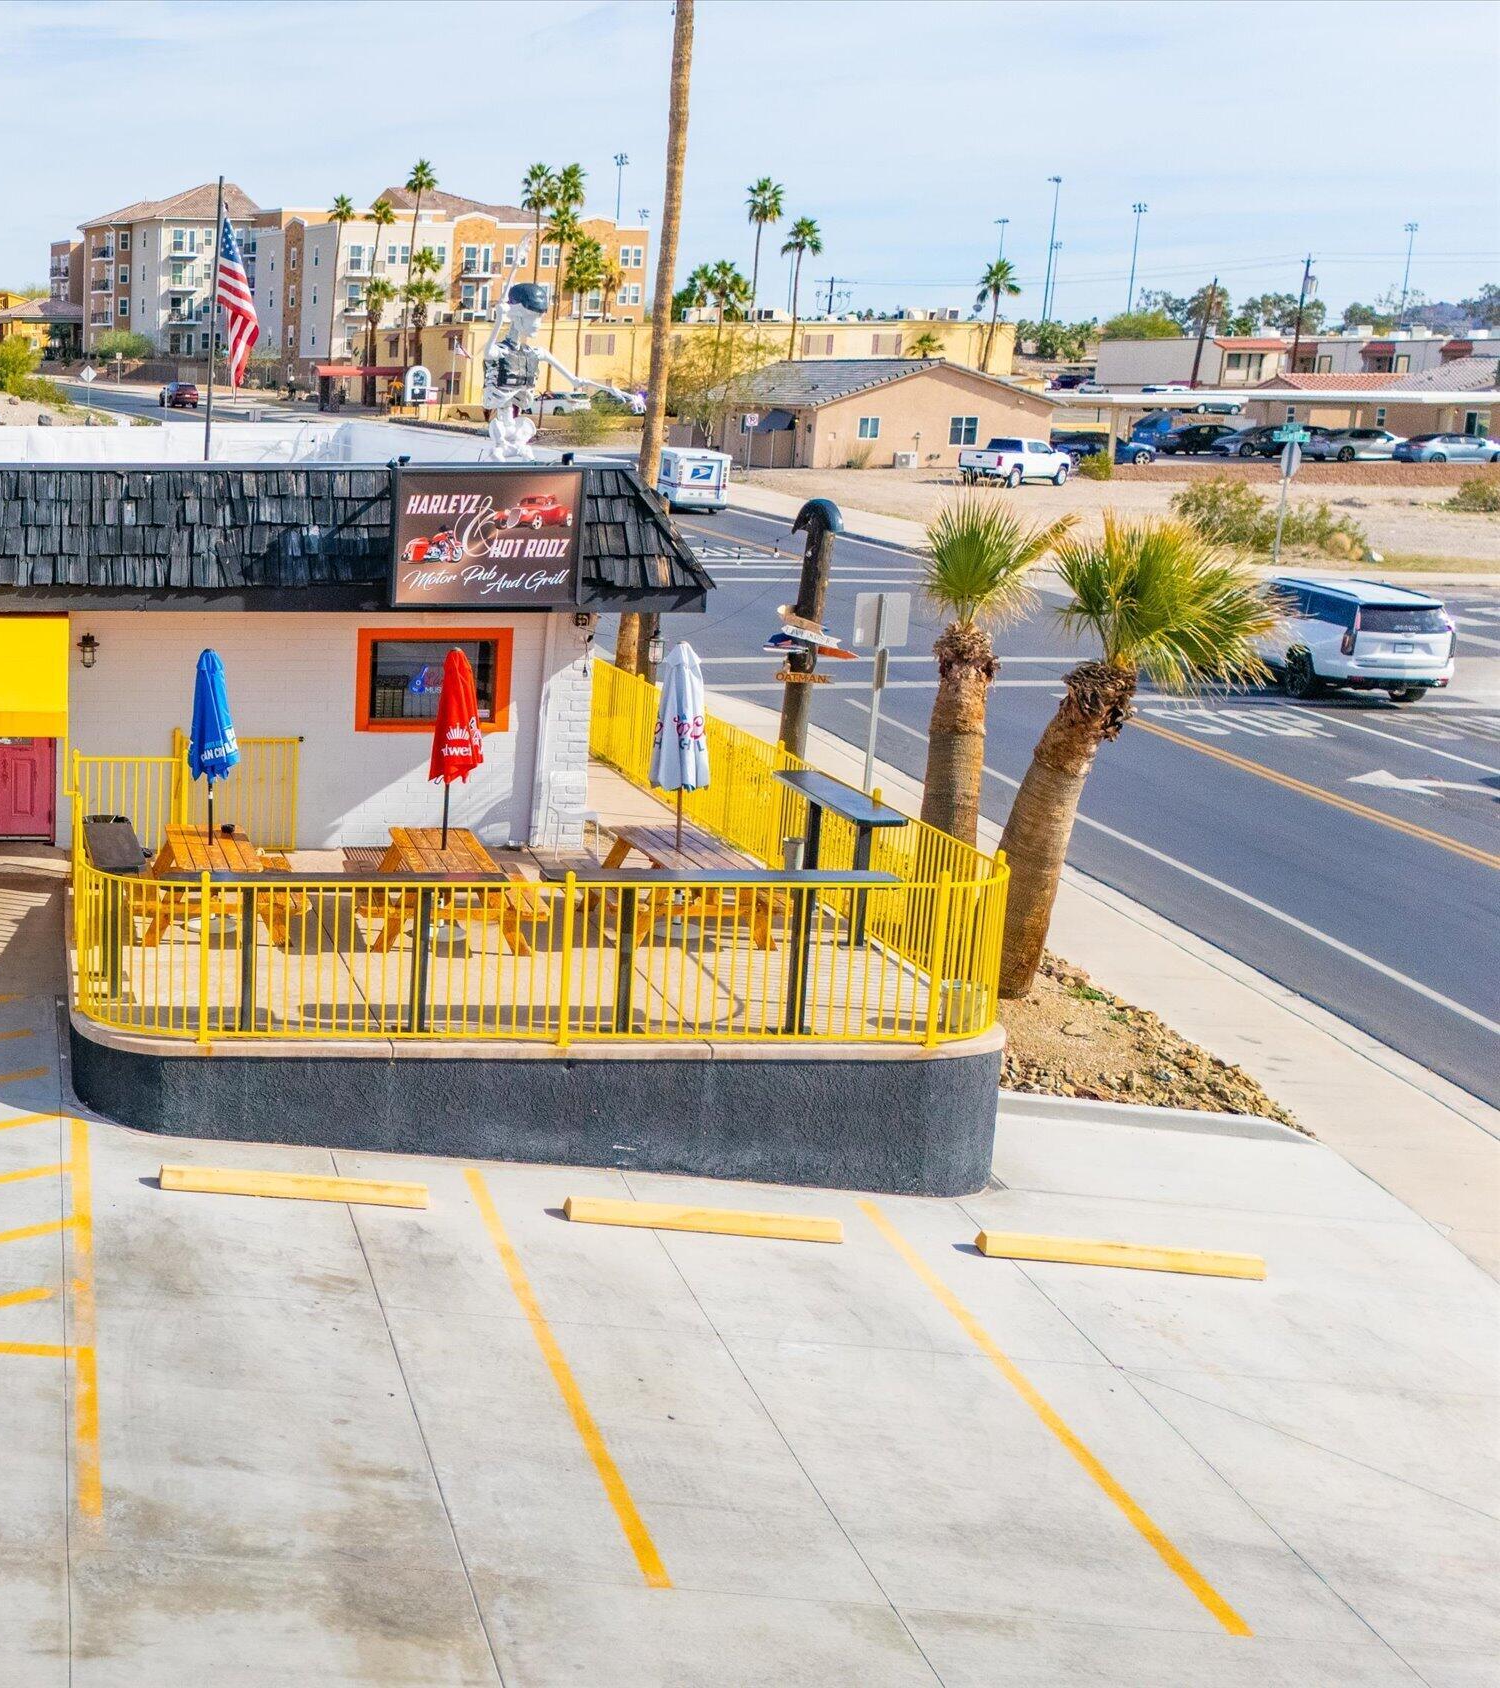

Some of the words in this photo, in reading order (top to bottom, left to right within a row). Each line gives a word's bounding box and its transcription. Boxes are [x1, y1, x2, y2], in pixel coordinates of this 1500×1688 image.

[406, 495, 481, 514] HARLEYZ
[488, 538, 524, 558] HOT
[525, 538, 570, 558] RODZ
[402, 569, 457, 591] Motor
[460, 564, 497, 587] Pub
[480, 573, 522, 595] And
[524, 569, 570, 593] Grill
[776, 672, 827, 684] OATMAN
[1142, 708, 1338, 738] STOP
